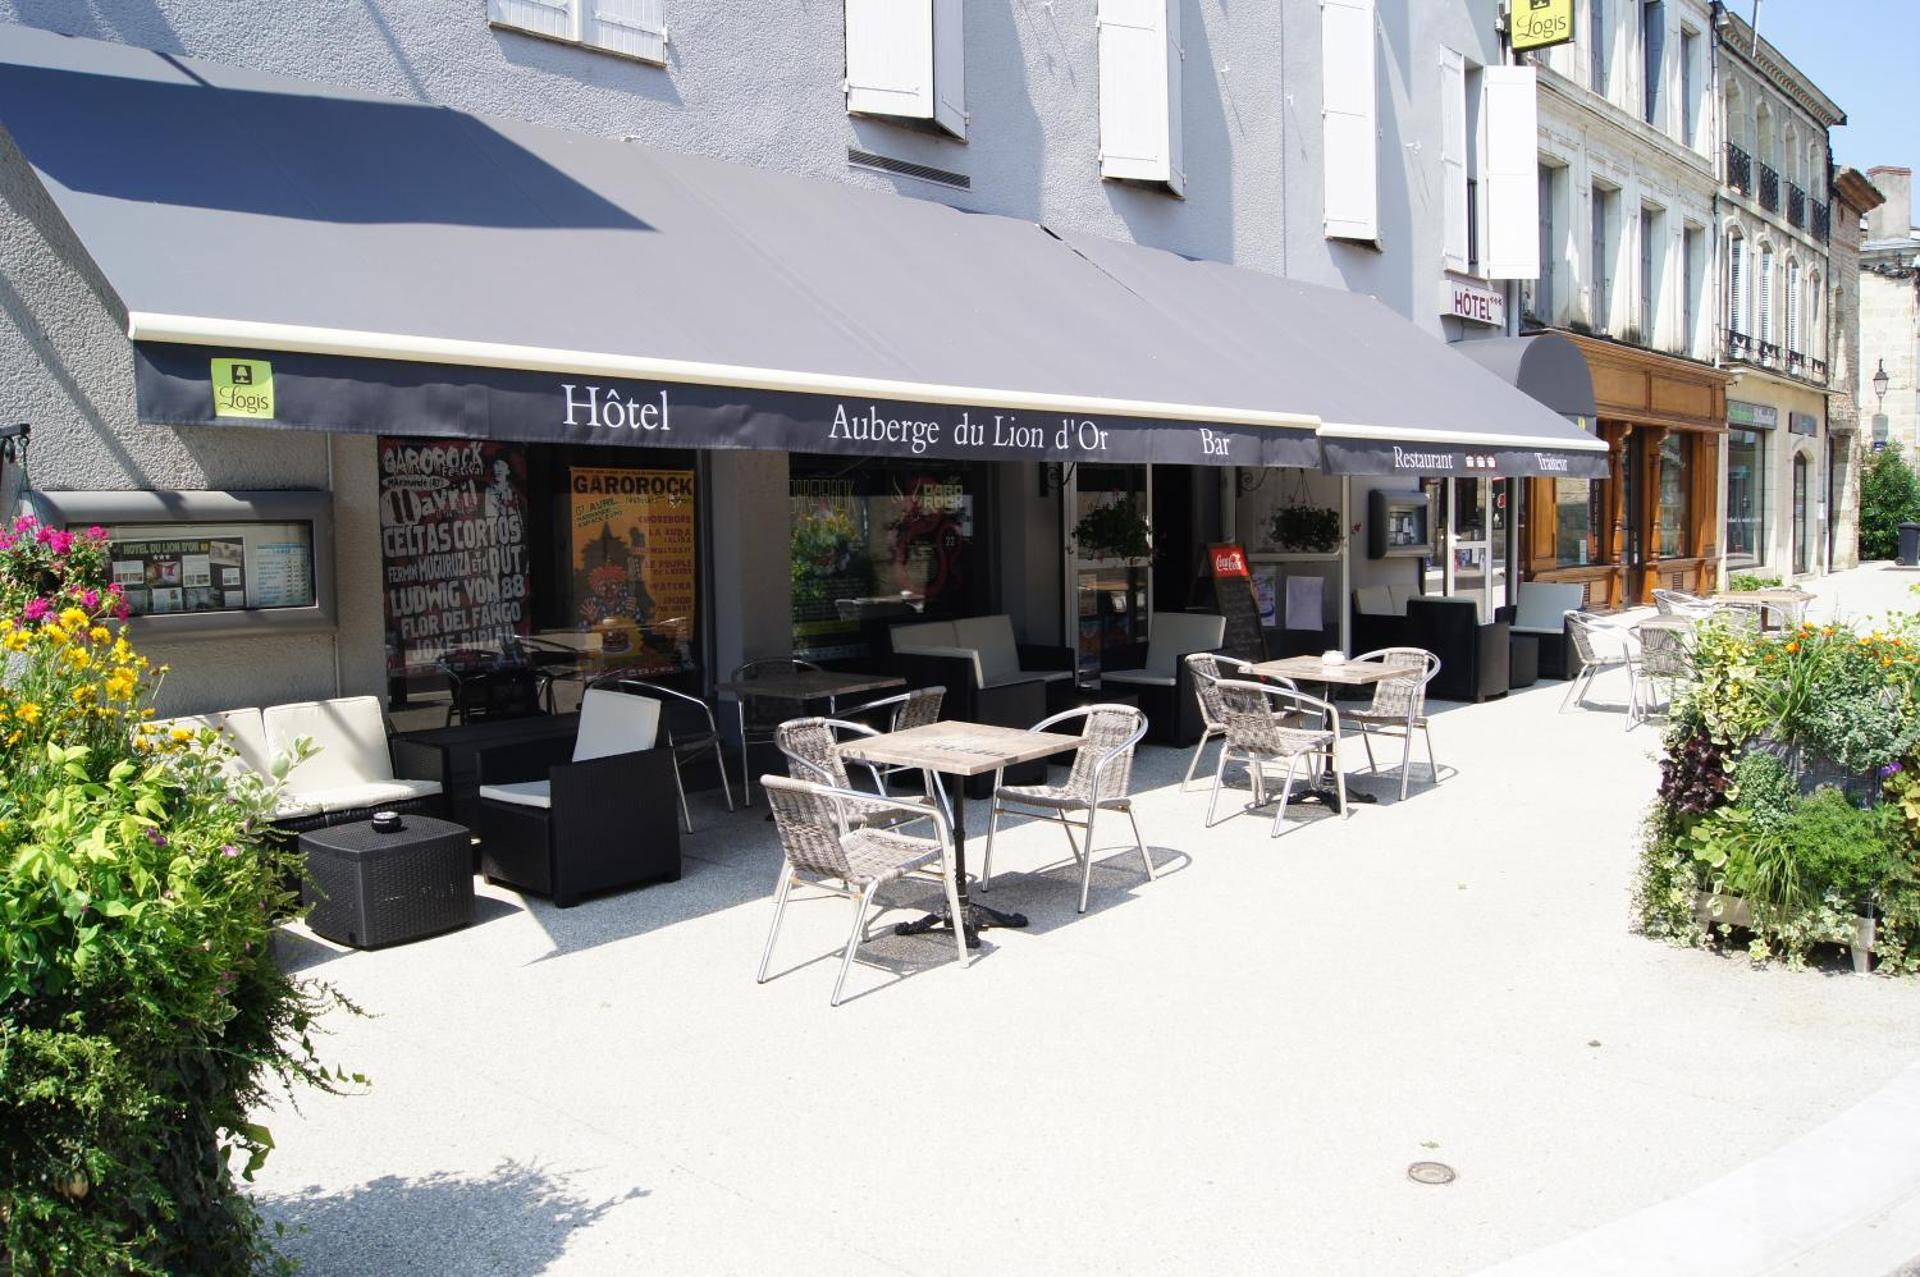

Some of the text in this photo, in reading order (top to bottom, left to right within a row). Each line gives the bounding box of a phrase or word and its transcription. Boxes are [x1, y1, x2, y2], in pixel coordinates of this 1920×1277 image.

[1515, 12, 1566, 39] Logis
[1454, 288, 1491, 320] HÔTEL
[219, 385, 269, 414] Logis
[561, 384, 671, 431] Hôtel
[828, 404, 1109, 454] Auberge du Lion d'Or
[1200, 428, 1231, 456] Bar
[1394, 446, 1454, 469] Restaurant
[574, 475, 693, 495] GAROROCK
[383, 515, 522, 558] CELTAS CORTOS
[418, 551, 471, 582] MUGURUZA
[488, 544, 522, 575] DUT
[390, 573, 526, 618] LUDWIG VON 88
[402, 601, 522, 640] FLOR DEL FANGO
